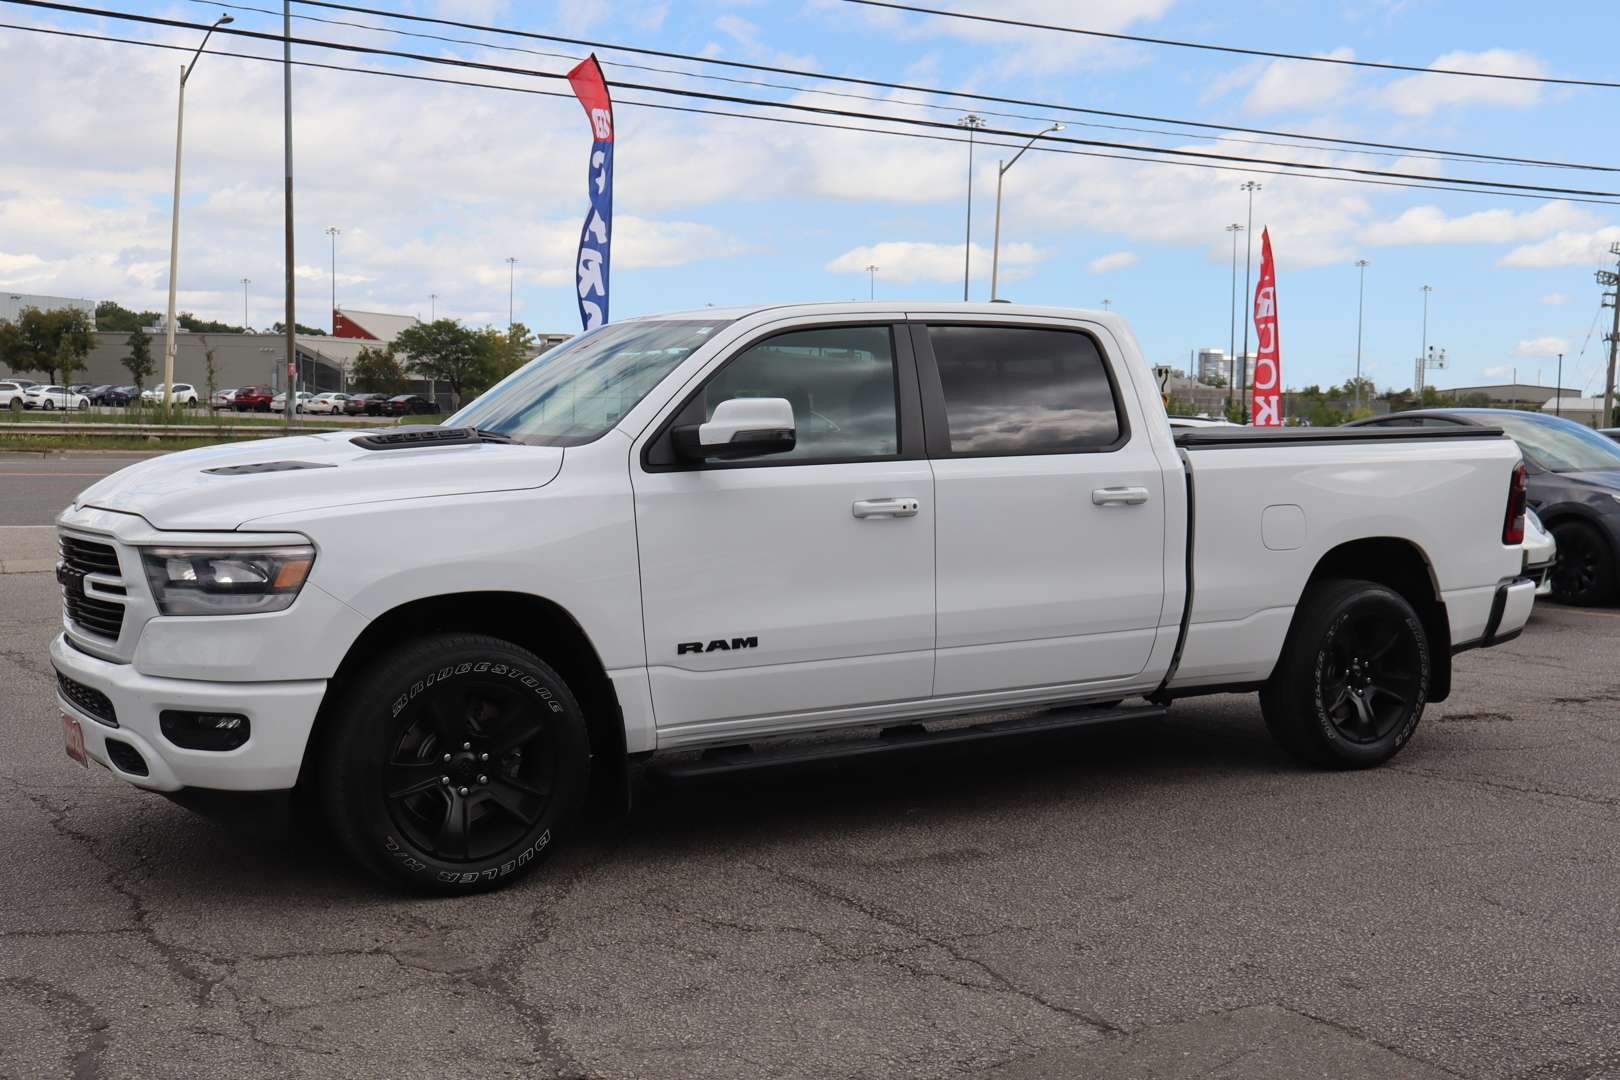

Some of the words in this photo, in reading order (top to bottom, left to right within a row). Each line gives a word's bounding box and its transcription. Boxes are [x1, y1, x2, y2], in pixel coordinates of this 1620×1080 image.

[677, 636, 758, 656] RAM
[391, 661, 565, 718] BRIDGESTONE
[437, 828, 552, 884] DUELER
